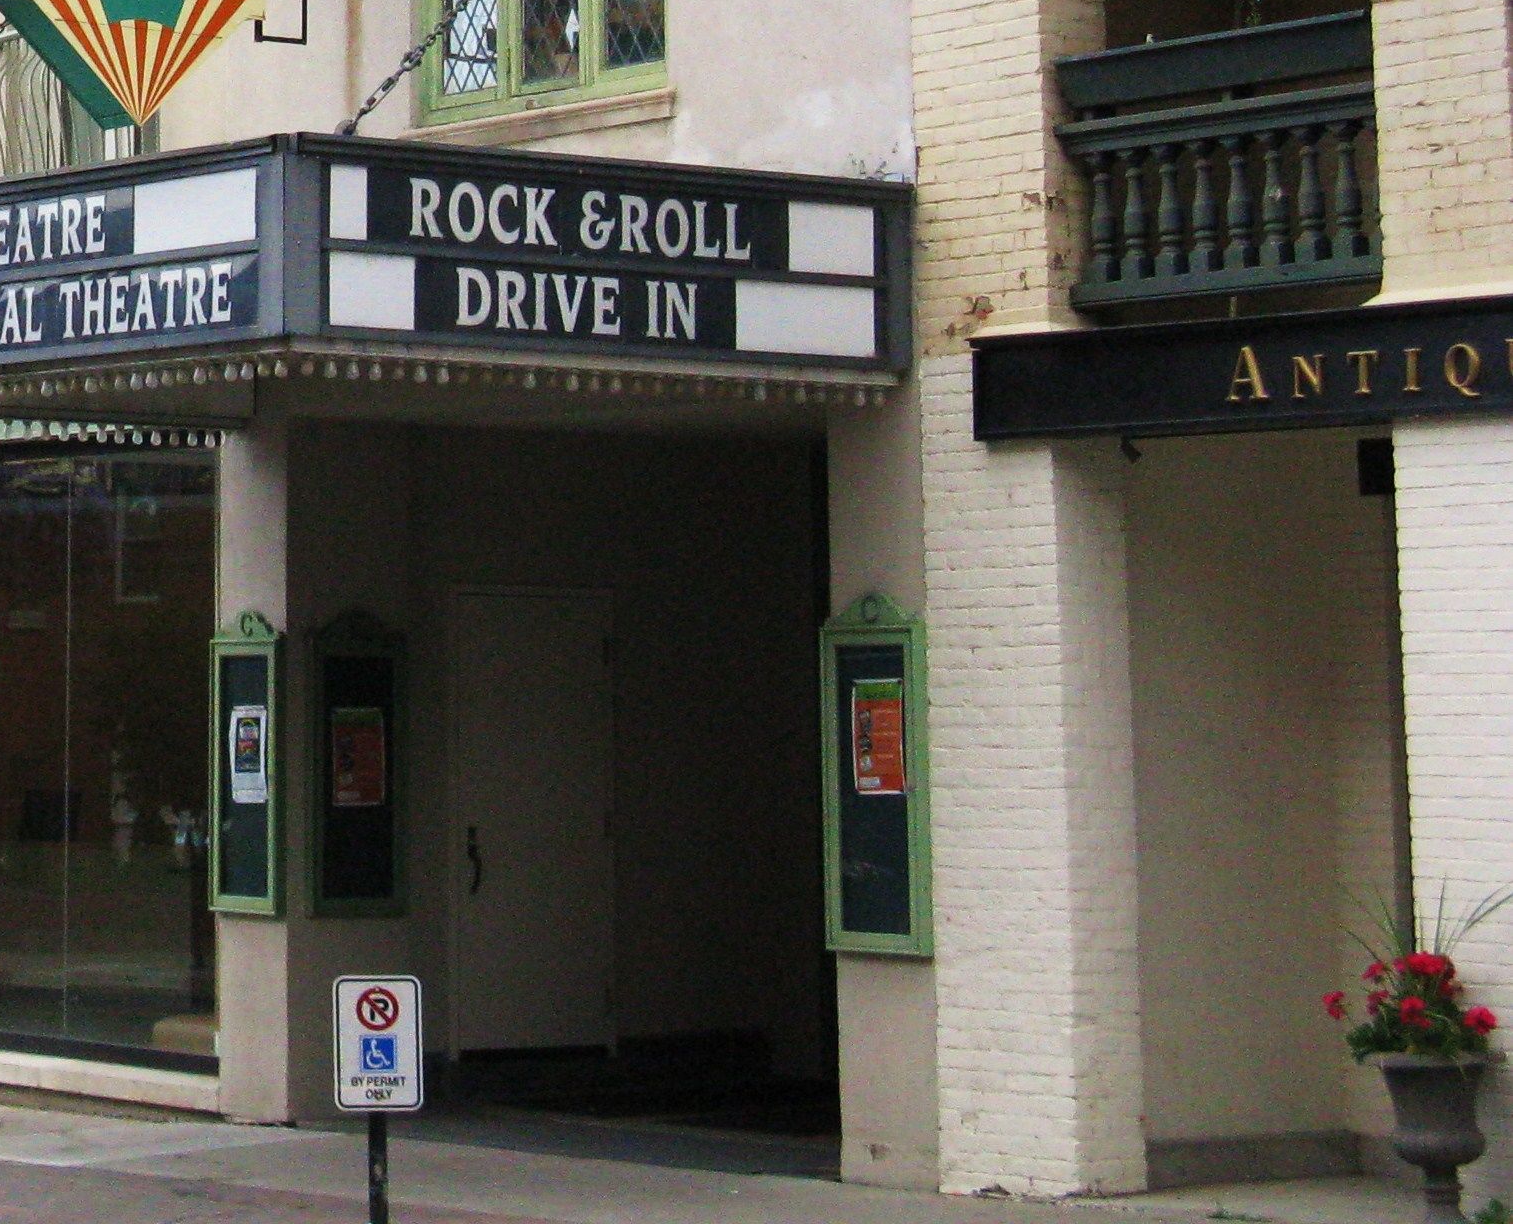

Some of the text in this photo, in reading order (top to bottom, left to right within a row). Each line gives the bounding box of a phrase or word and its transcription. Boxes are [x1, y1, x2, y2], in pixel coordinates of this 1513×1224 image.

[409, 176, 557, 247] ROCK
[59, 262, 233, 340] THEATRE
[455, 266, 699, 340] DRIVE IN
[1224, 337, 1513, 403] ANTIQ
[351, 1076, 406, 1087] BY PERMIT
[365, 1088, 393, 1100] ONLY
